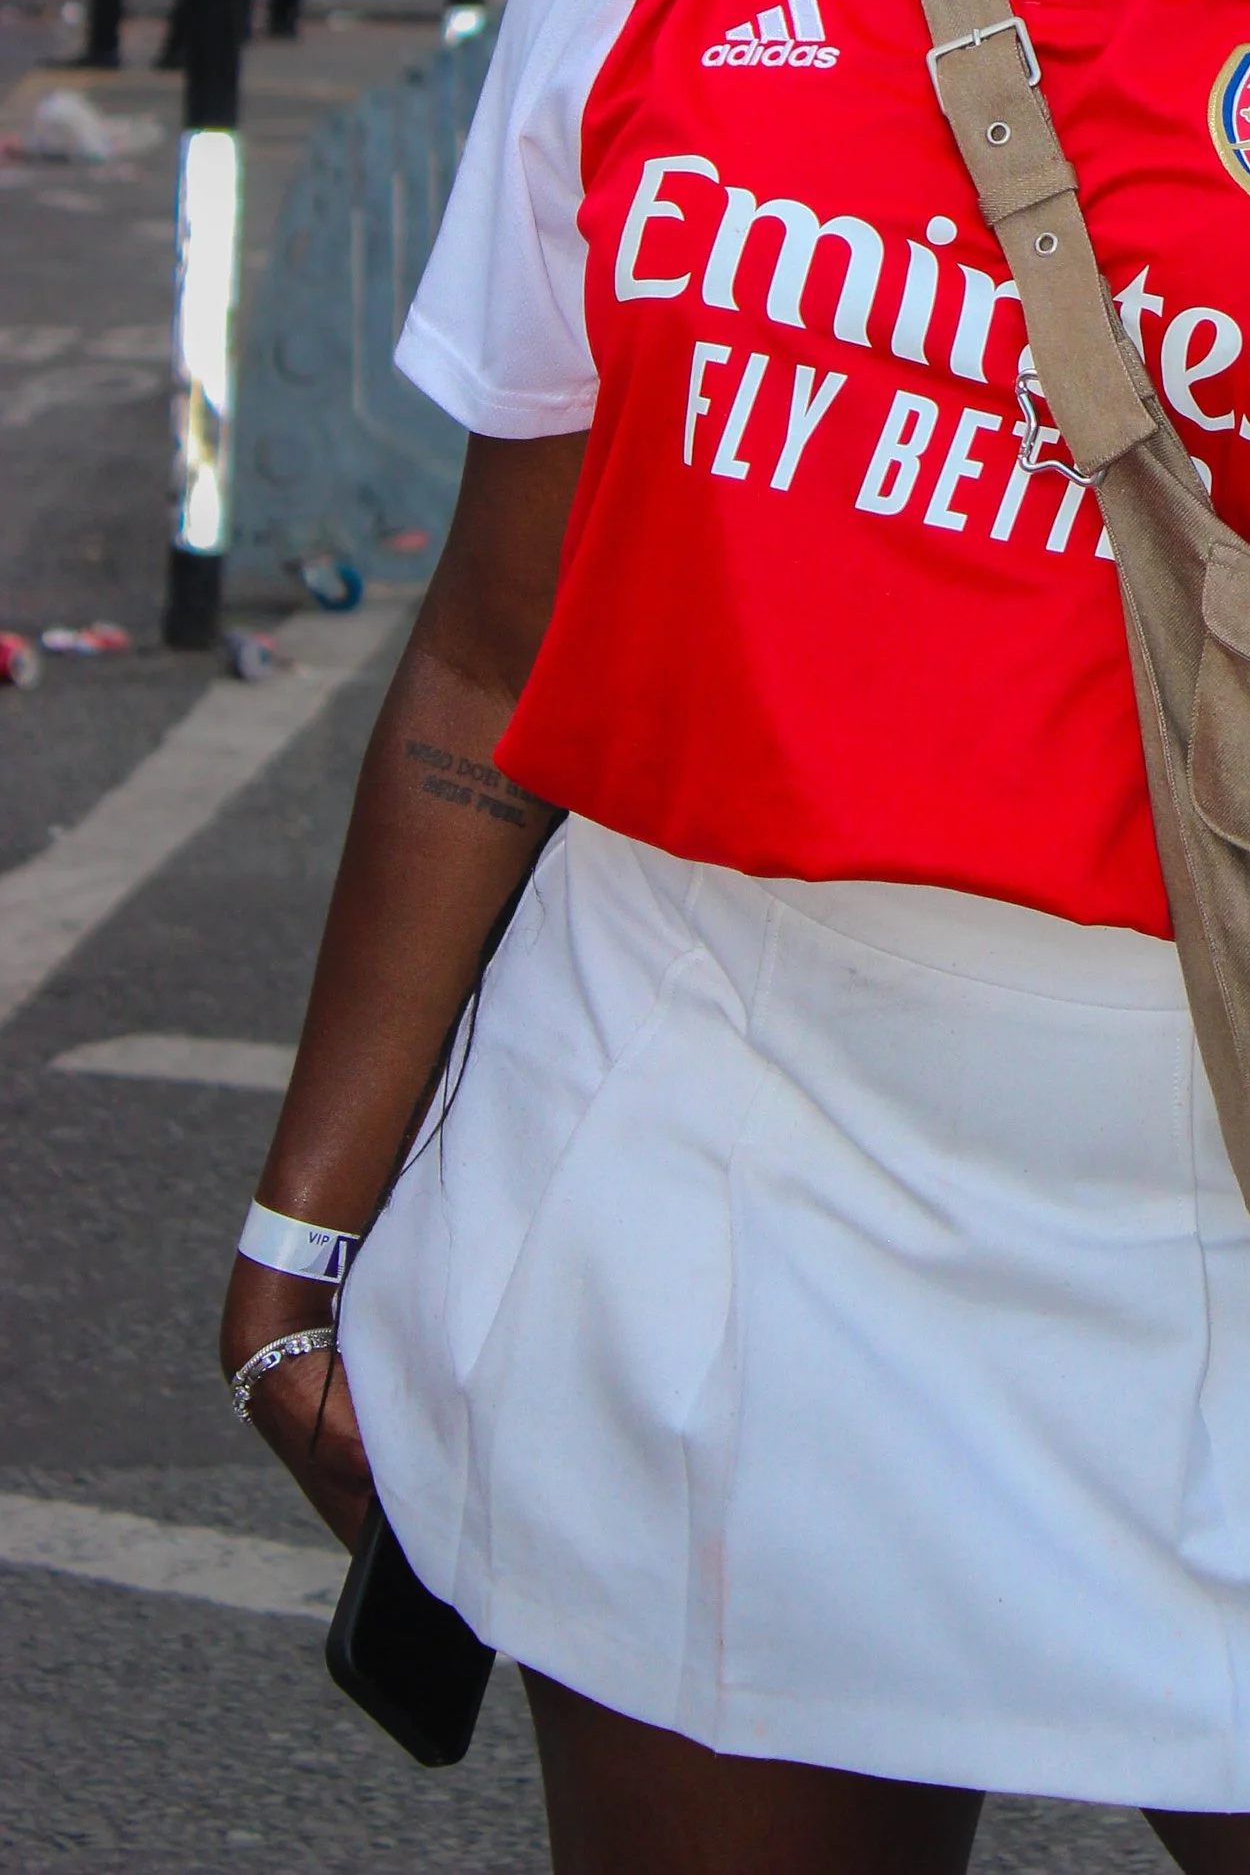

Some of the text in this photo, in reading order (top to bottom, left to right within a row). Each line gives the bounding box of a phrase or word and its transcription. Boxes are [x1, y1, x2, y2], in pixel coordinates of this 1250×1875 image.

[701, 37, 841, 68] adidas
[683, 340, 848, 492] FLY
[309, 1231, 330, 1246] VIP
